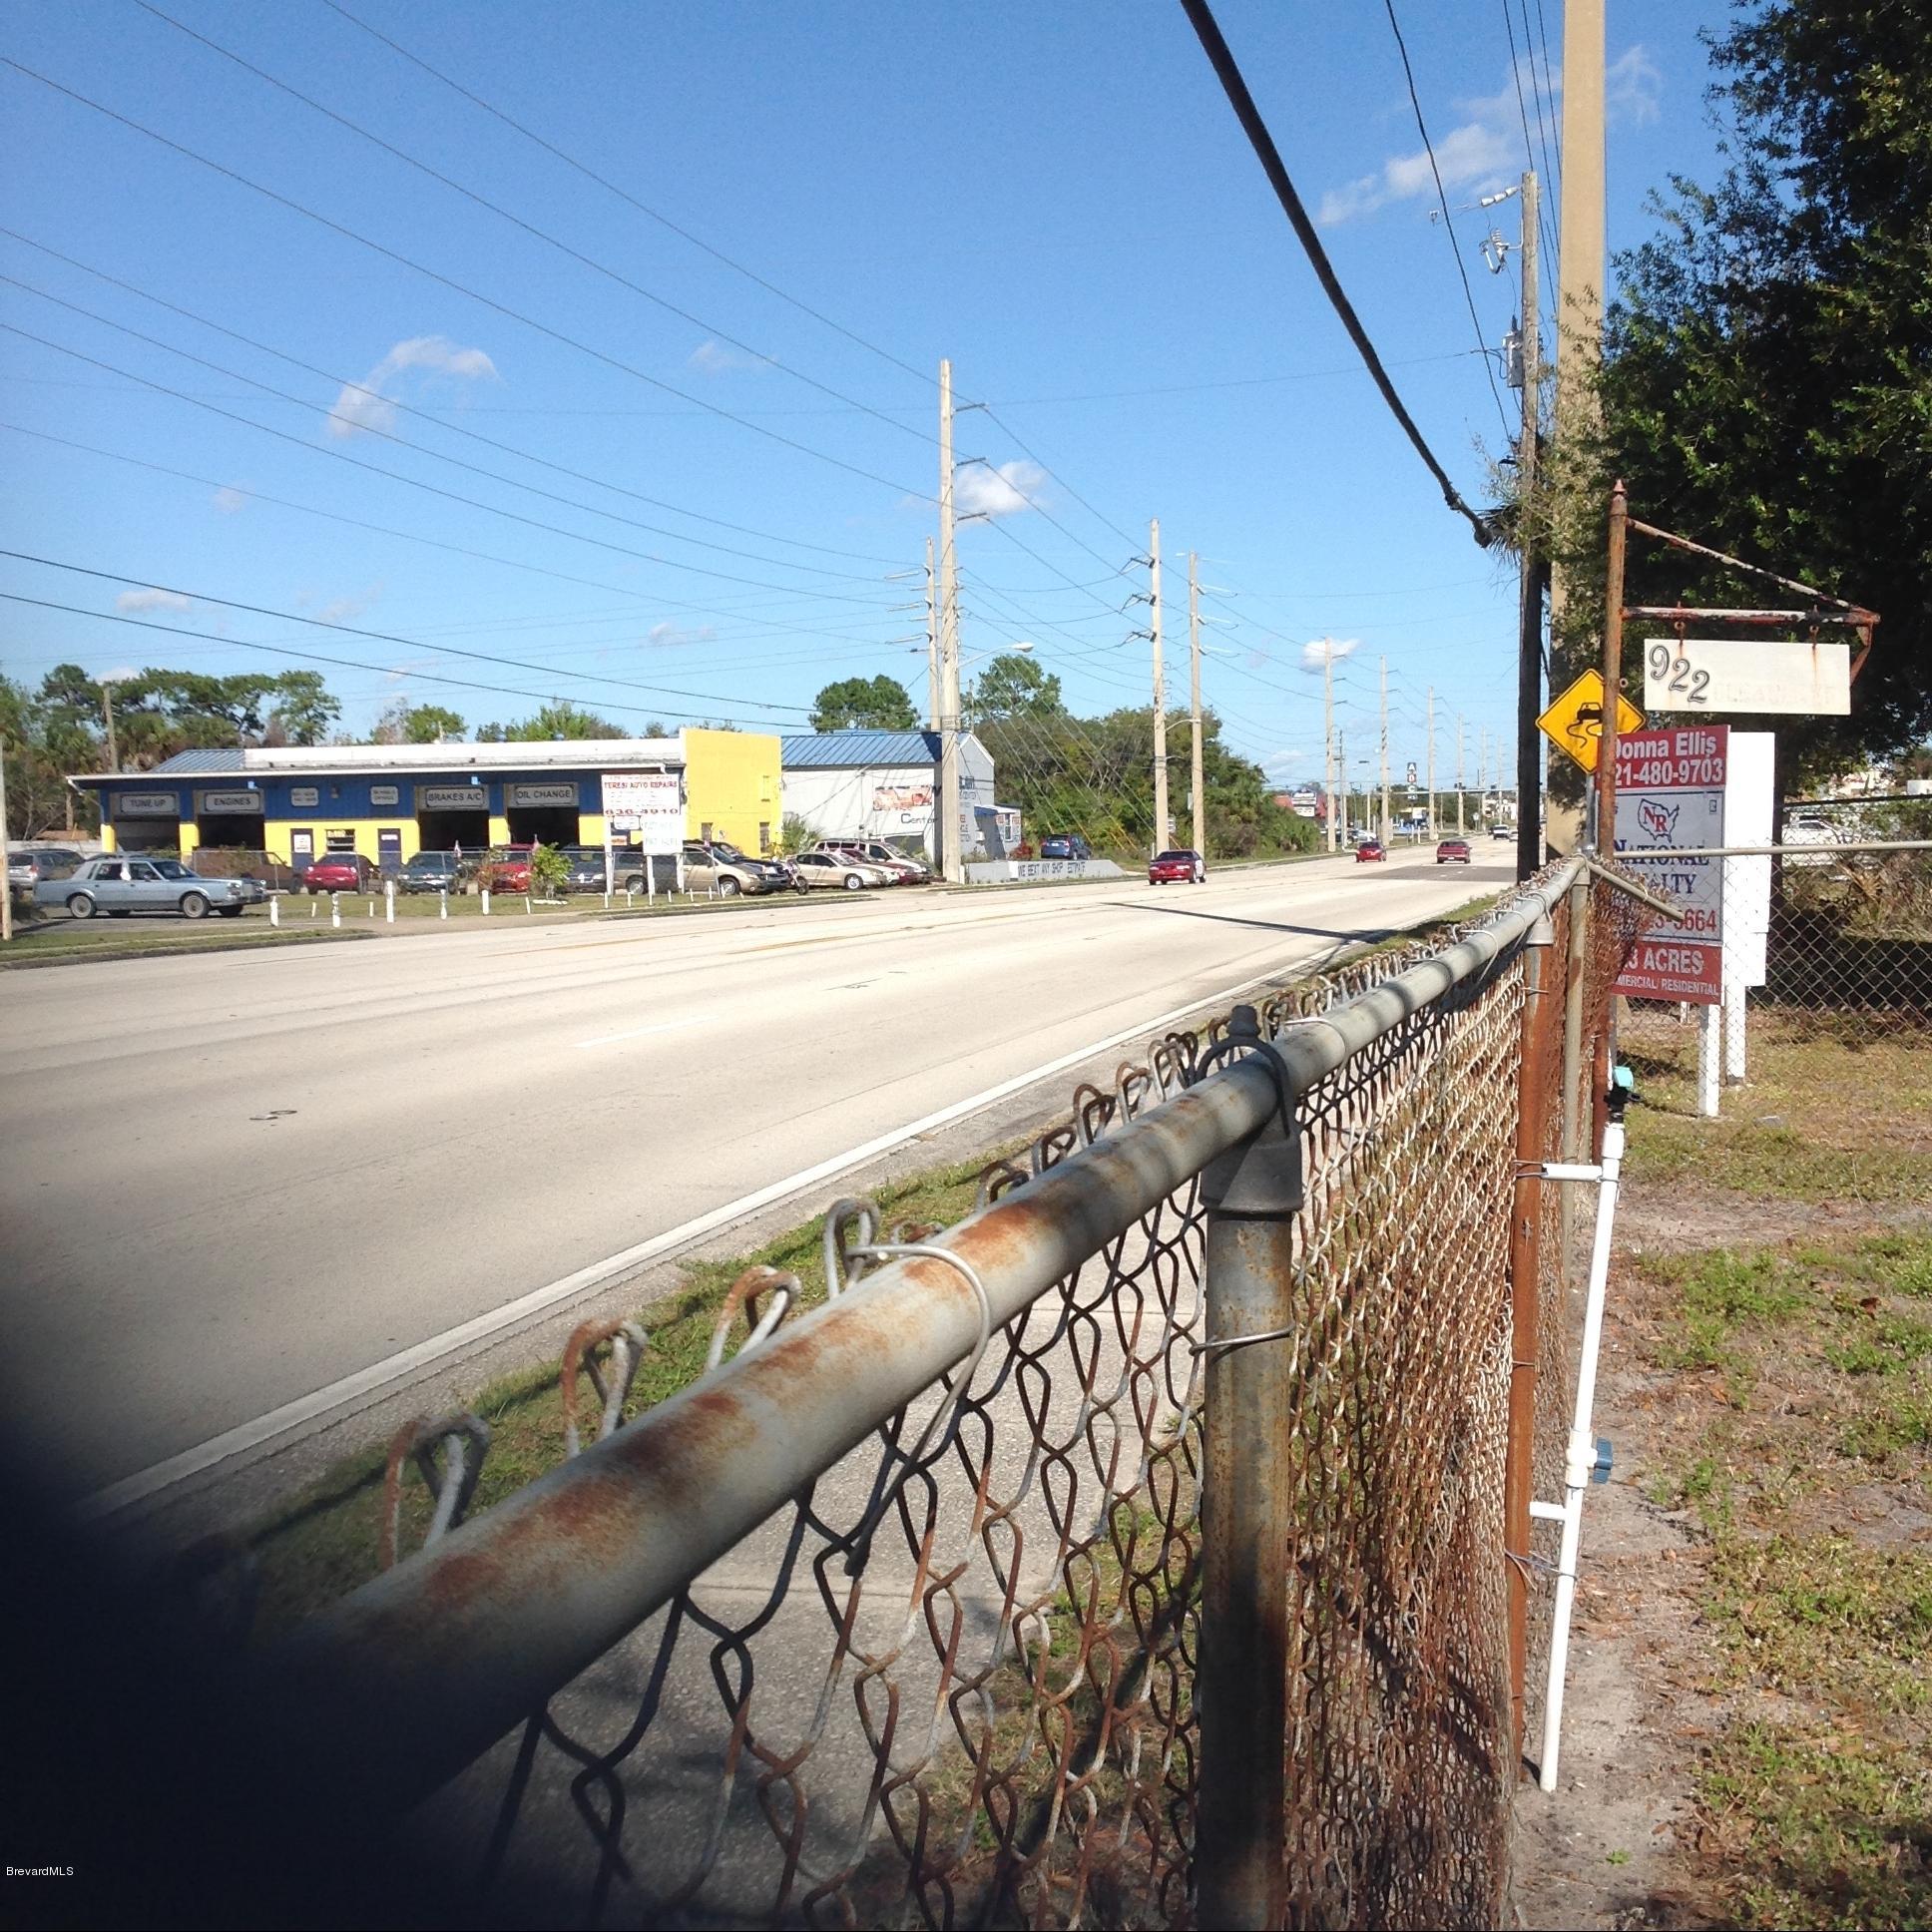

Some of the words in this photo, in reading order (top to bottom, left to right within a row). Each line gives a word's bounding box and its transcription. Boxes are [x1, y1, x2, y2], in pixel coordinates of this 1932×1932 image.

[1649, 645, 1710, 705] 922
[1676, 730, 1717, 756] Ellis
[1616, 758, 1723, 786] 21-480-9703
[154, 798, 167, 808] UP
[214, 796, 251, 806] ENGINES
[428, 792, 465, 802] BRAKES
[517, 790, 531, 799] OIL
[533, 789, 571, 799] CHANGE
[1647, 873, 1697, 894] ALTY
[1643, 946, 1705, 976] ACRES
[1661, 977, 1720, 997] RESIDENTIAL
